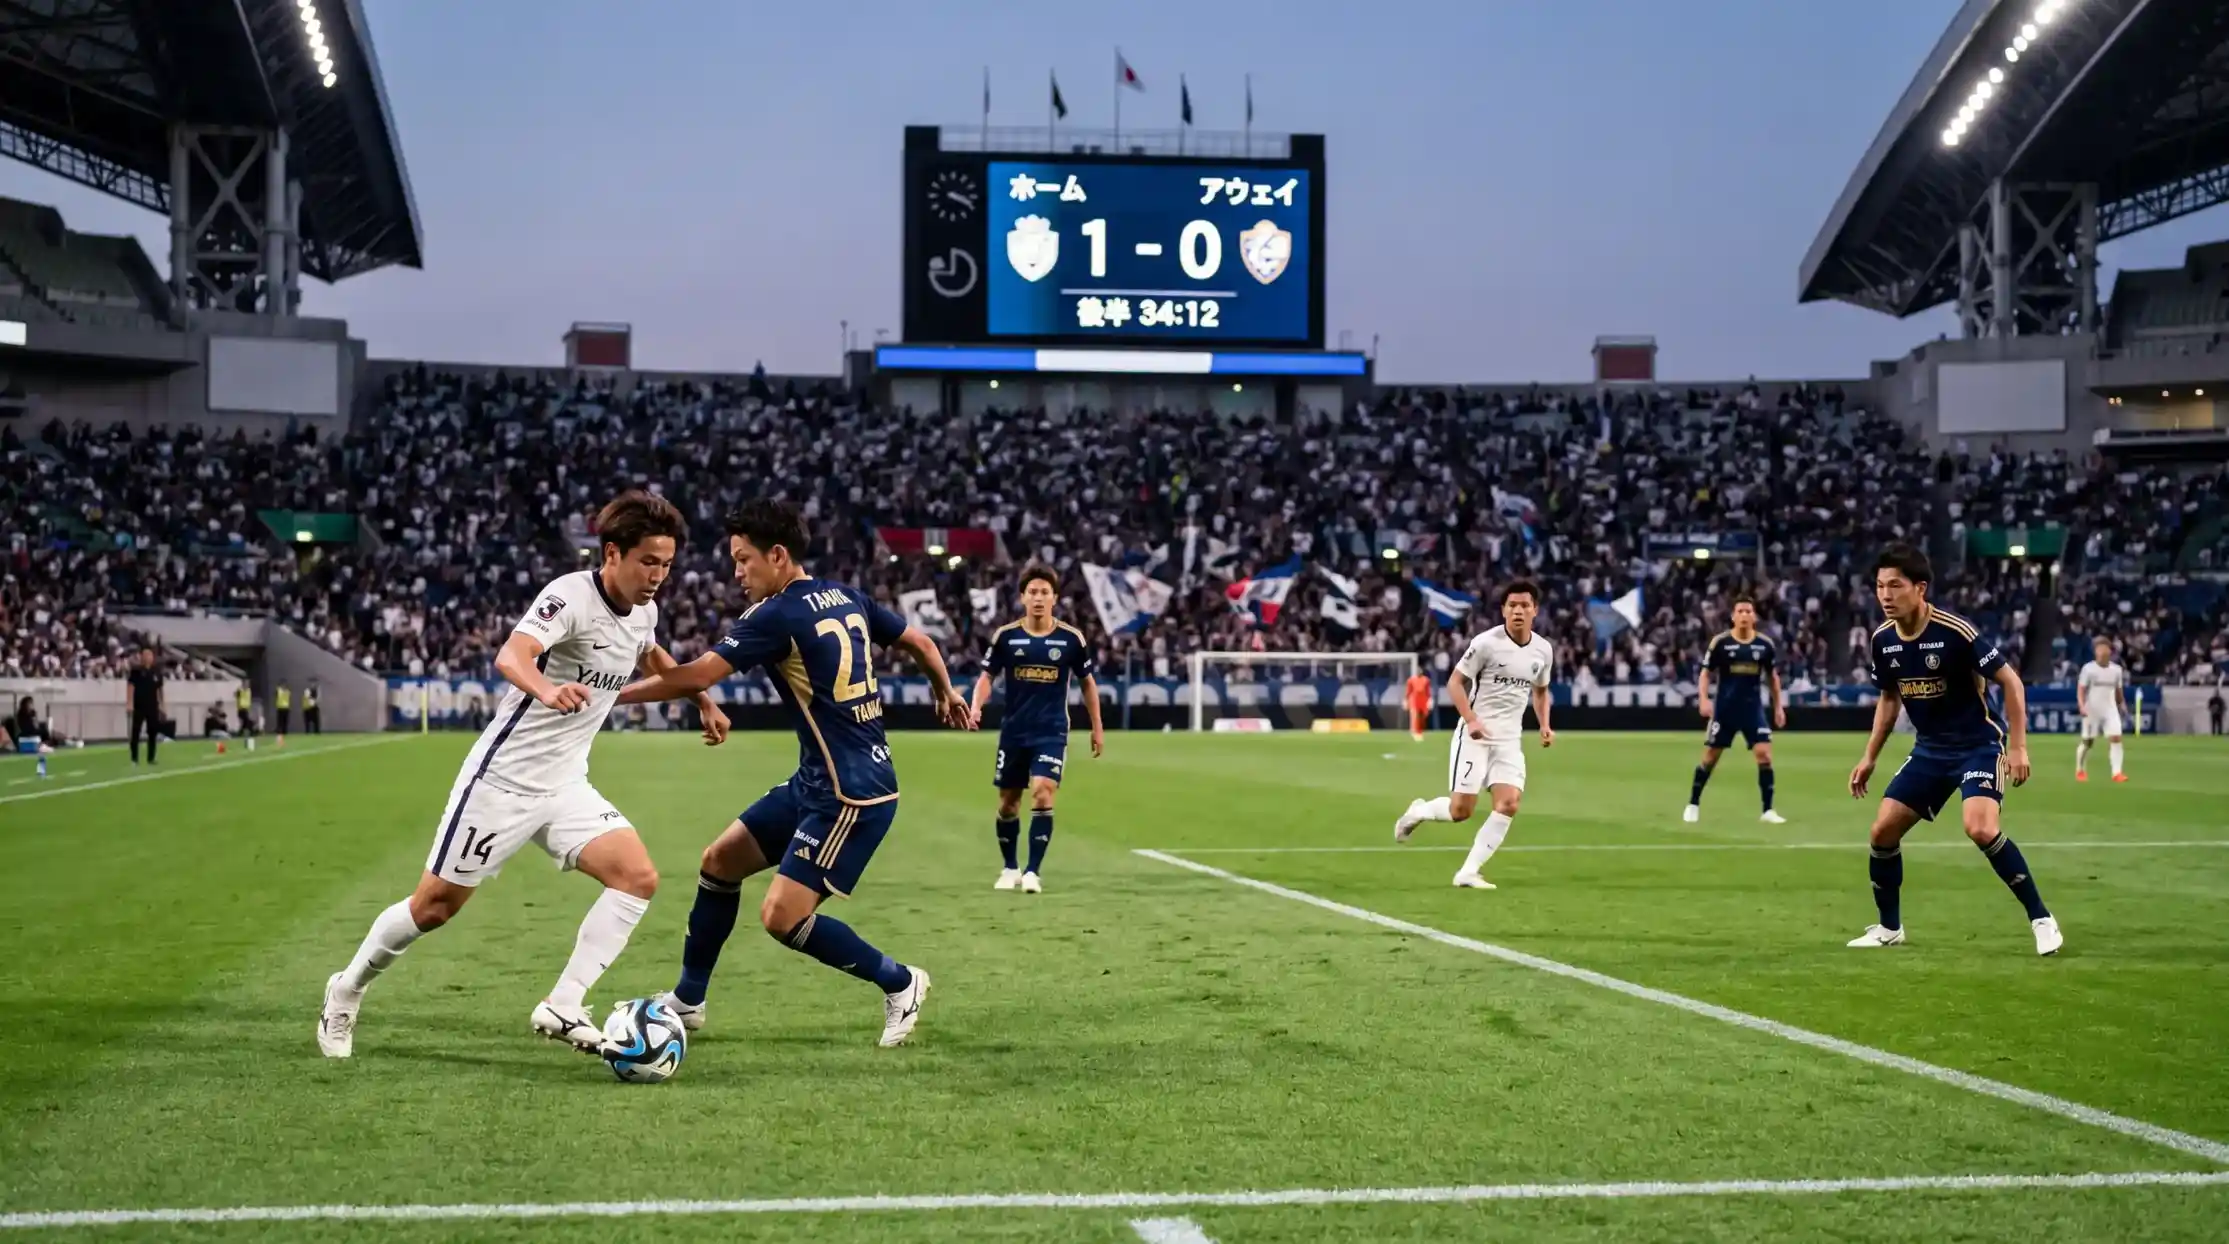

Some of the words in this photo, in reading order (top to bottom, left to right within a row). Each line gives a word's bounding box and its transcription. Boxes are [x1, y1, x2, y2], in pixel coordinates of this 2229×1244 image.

[1009, 173, 1087, 203] ホーム
[1199, 176, 1298, 206] アウェイ
[1081, 218, 1106, 277] 1
[1135, 242, 1162, 256] -
[1179, 219, 1222, 280] 0
[1077, 296, 1132, 327] 後半
[1139, 299, 1219, 327] 34:12
[815, 613, 878, 703] 22
[1464, 761, 1473, 778] 7
[460, 826, 498, 865] 14
